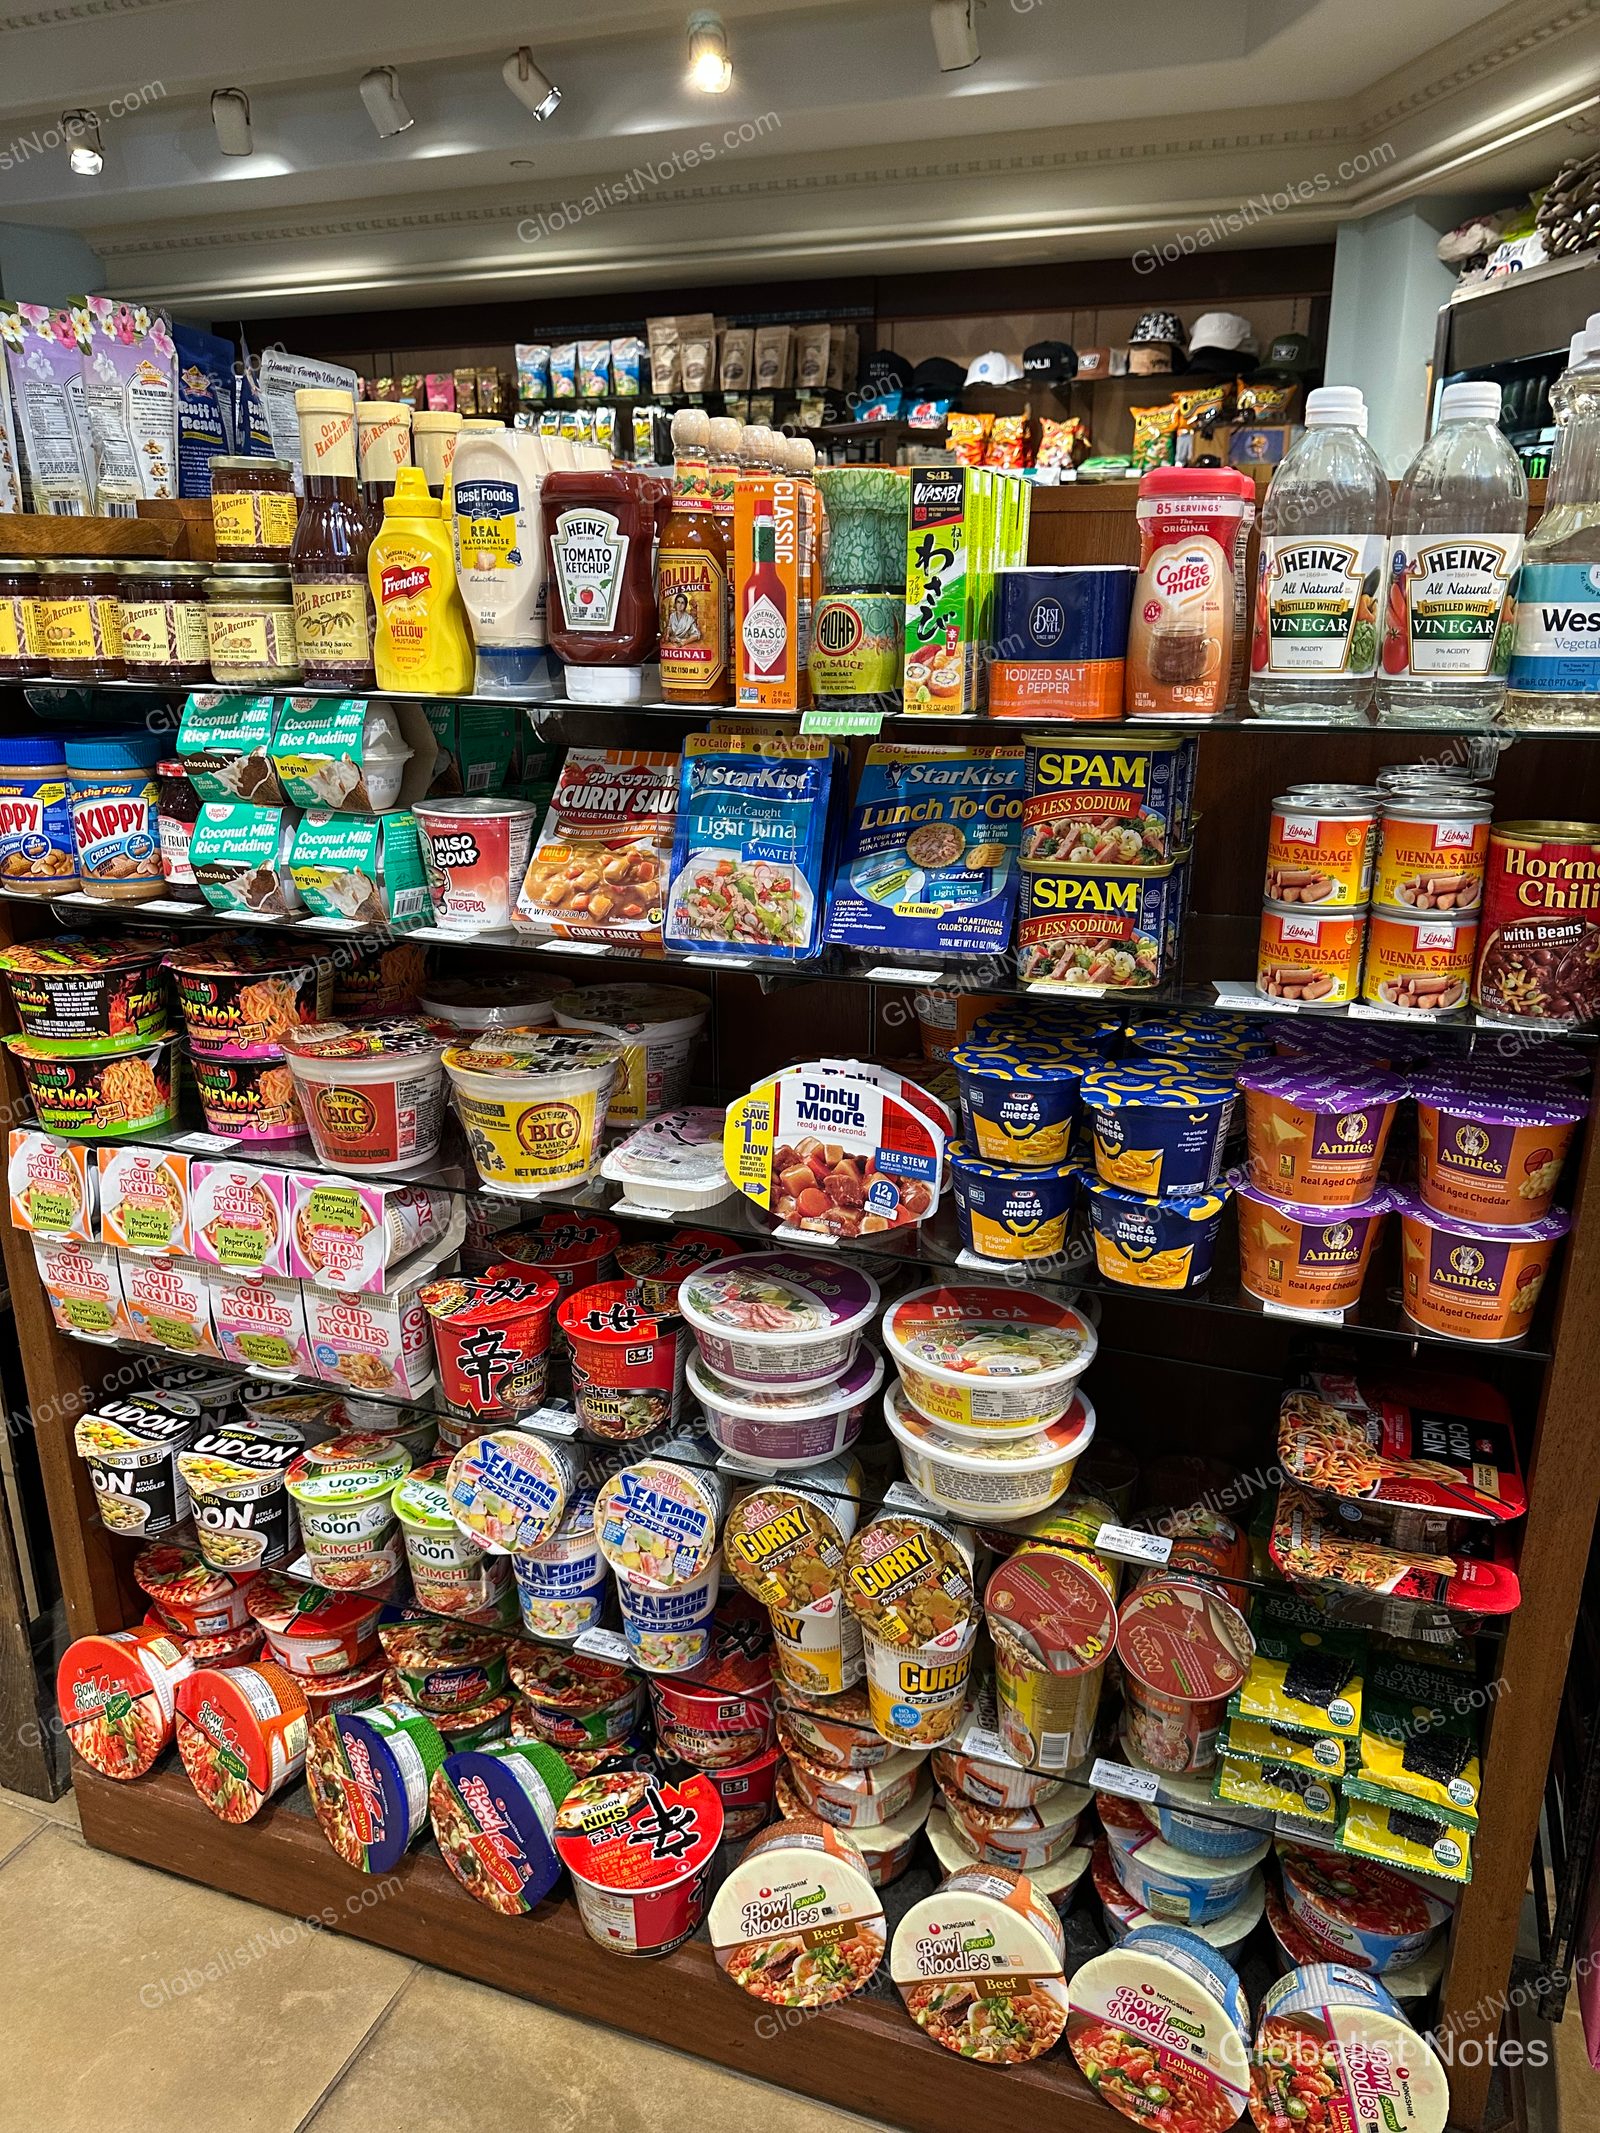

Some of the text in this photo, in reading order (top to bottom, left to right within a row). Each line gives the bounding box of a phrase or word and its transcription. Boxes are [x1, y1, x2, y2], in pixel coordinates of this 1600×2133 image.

[181, 416, 222, 435] Ready
[927, 470, 950, 481] S&B
[458, 488, 514, 504] Best Foods
[914, 483, 962, 504] WASABI
[1156, 503, 1219, 515] 85 SERVINGS
[471, 526, 500, 537] REAL
[567, 521, 605, 538] HEINZ
[773, 482, 794, 564] CLASSIC
[1163, 524, 1209, 533] ORIGINAL
[463, 538, 510, 546] MAYONNAISE
[951, 525, 962, 552] ねり
[563, 548, 611, 562] TOMATO
[1284, 550, 1348, 574] HEINZ
[1428, 550, 1497, 574] HEINZ
[566, 562, 610, 574] KETCHUP
[1157, 563, 1209, 586] Coffee
[383, 572, 425, 595] French's
[915, 533, 956, 642] わさび
[1167, 575, 1210, 595] mate
[1282, 582, 1344, 595] All Natural
[1280, 600, 1342, 613] DISTILLED WHITE
[1424, 602, 1490, 614] DISTILLED WHITE
[391, 625, 423, 639] YELLOW
[744, 627, 785, 638] TABASCO
[820, 610, 853, 650] ALOHA
[1271, 618, 1348, 634] VINEGAR
[1414, 619, 1494, 634] VINEGAR
[661, 650, 706, 659] ORIGINAL
[1005, 667, 1085, 680] IODIZED SALT
[284, 714, 361, 730] Coconut Milk
[808, 714, 878, 727] MADE IN HAWAII
[279, 732, 357, 747] Rice Pudding
[693, 738, 824, 752] 70 Calories 17g Protein
[280, 764, 308, 775] original
[709, 765, 809, 790] StarKist
[907, 763, 1019, 786] StarKist
[1037, 753, 1148, 788] SPAM
[560, 785, 679, 813] CURRY SAU
[1042, 797, 1072, 815] LESS
[1075, 795, 1132, 813] SODIUM
[577, 812, 628, 821] VEGETABLES
[717, 805, 780, 818] Wild Caught
[860, 795, 1023, 831] Lunch To-Go
[74, 802, 145, 848] SKIPPY
[200, 824, 276, 839] Coconut Milk
[697, 815, 797, 840] Light Tuna
[1286, 825, 1314, 837] Libby's
[298, 830, 373, 844] Coconut Milk
[434, 835, 473, 852] MISO
[90, 842, 121, 863] CREAMY
[195, 840, 273, 856] Rice Pudding
[293, 848, 368, 862] Rice Pudding
[543, 847, 567, 858] MILD
[758, 848, 797, 861] WATER
[1293, 850, 1353, 862] SAUSAGE
[1395, 849, 1445, 864] VIENNA
[436, 850, 478, 866] SOUP
[195, 871, 231, 880] chocolate
[294, 876, 322, 885] original
[1033, 878, 1141, 912] SPAM
[1518, 882, 1599, 908] Chili
[448, 899, 486, 913] TOFU
[1504, 927, 1582, 946] with Beans
[1379, 948, 1426, 966] VIENNA
[803, 1082, 860, 1112] Dinty
[326, 1106, 369, 1124] BIG
[742, 1108, 770, 1120] SAVE
[796, 1101, 865, 1128] Moore
[1003, 1102, 1039, 1112] mac &
[333, 1122, 365, 1132] RAMEN
[529, 1122, 575, 1141] BIG
[797, 1121, 818, 1132] ready
[838, 1126, 867, 1137] seconds
[743, 1143, 769, 1156] NOW
[1316, 1141, 1373, 1156] Annie's
[881, 1151, 929, 1168] BEEF STEW
[1440, 1150, 1503, 1174] Annie's
[130, 1167, 155, 1181] CUP
[1301, 1174, 1375, 1189] Real Aged Cheddar
[120, 1179, 167, 1197] NOODLES
[145, 1268, 181, 1289] CUP
[133, 1286, 196, 1312] NOODLES
[458, 1327, 522, 1404] 辛
[586, 1400, 619, 1414] SHIN
[925, 1402, 963, 1420] FLAVOR
[99, 1400, 188, 1434] UDON
[1422, 1418, 1448, 1456] MEIN
[1453, 1422, 1471, 1460] CHOW
[194, 1435, 297, 1461] UDON
[470, 1438, 559, 1513] SEAFOOD
[734, 1507, 806, 1563] CURRY
[320, 1542, 374, 1555] KIMCHI
[1140, 1544, 1168, 1554] 4.99
[418, 1566, 468, 1580] KIMCHI
[1332, 1703, 1350, 1713] USDA
[1129, 1776, 1156, 1791] 2.39
[472, 1774, 508, 1830] Bowl
[460, 1776, 511, 1859] Noodles
[584, 1806, 627, 1829] SHIN
[627, 1786, 701, 1860] 辛
[773, 1880, 807, 1893] NONGSHIM
[743, 1892, 792, 1919] Bowl
[795, 1891, 826, 1909] SAVORY
[741, 1906, 819, 1937] Noodles
[942, 1920, 975, 1931] NONGSHIM
[812, 1923, 845, 1940] Beef
[918, 1933, 961, 1958] Bowl
[966, 1936, 995, 1950] SAVORY
[918, 1952, 991, 1976] Noodles
[985, 1976, 1017, 1991] Beef
[1118, 1985, 1170, 2019] Bowl
[1156, 1992, 1194, 2016] NONGSHIM
[1108, 2001, 1190, 2050] Noodles
[1166, 2054, 1209, 2082] Lobster
